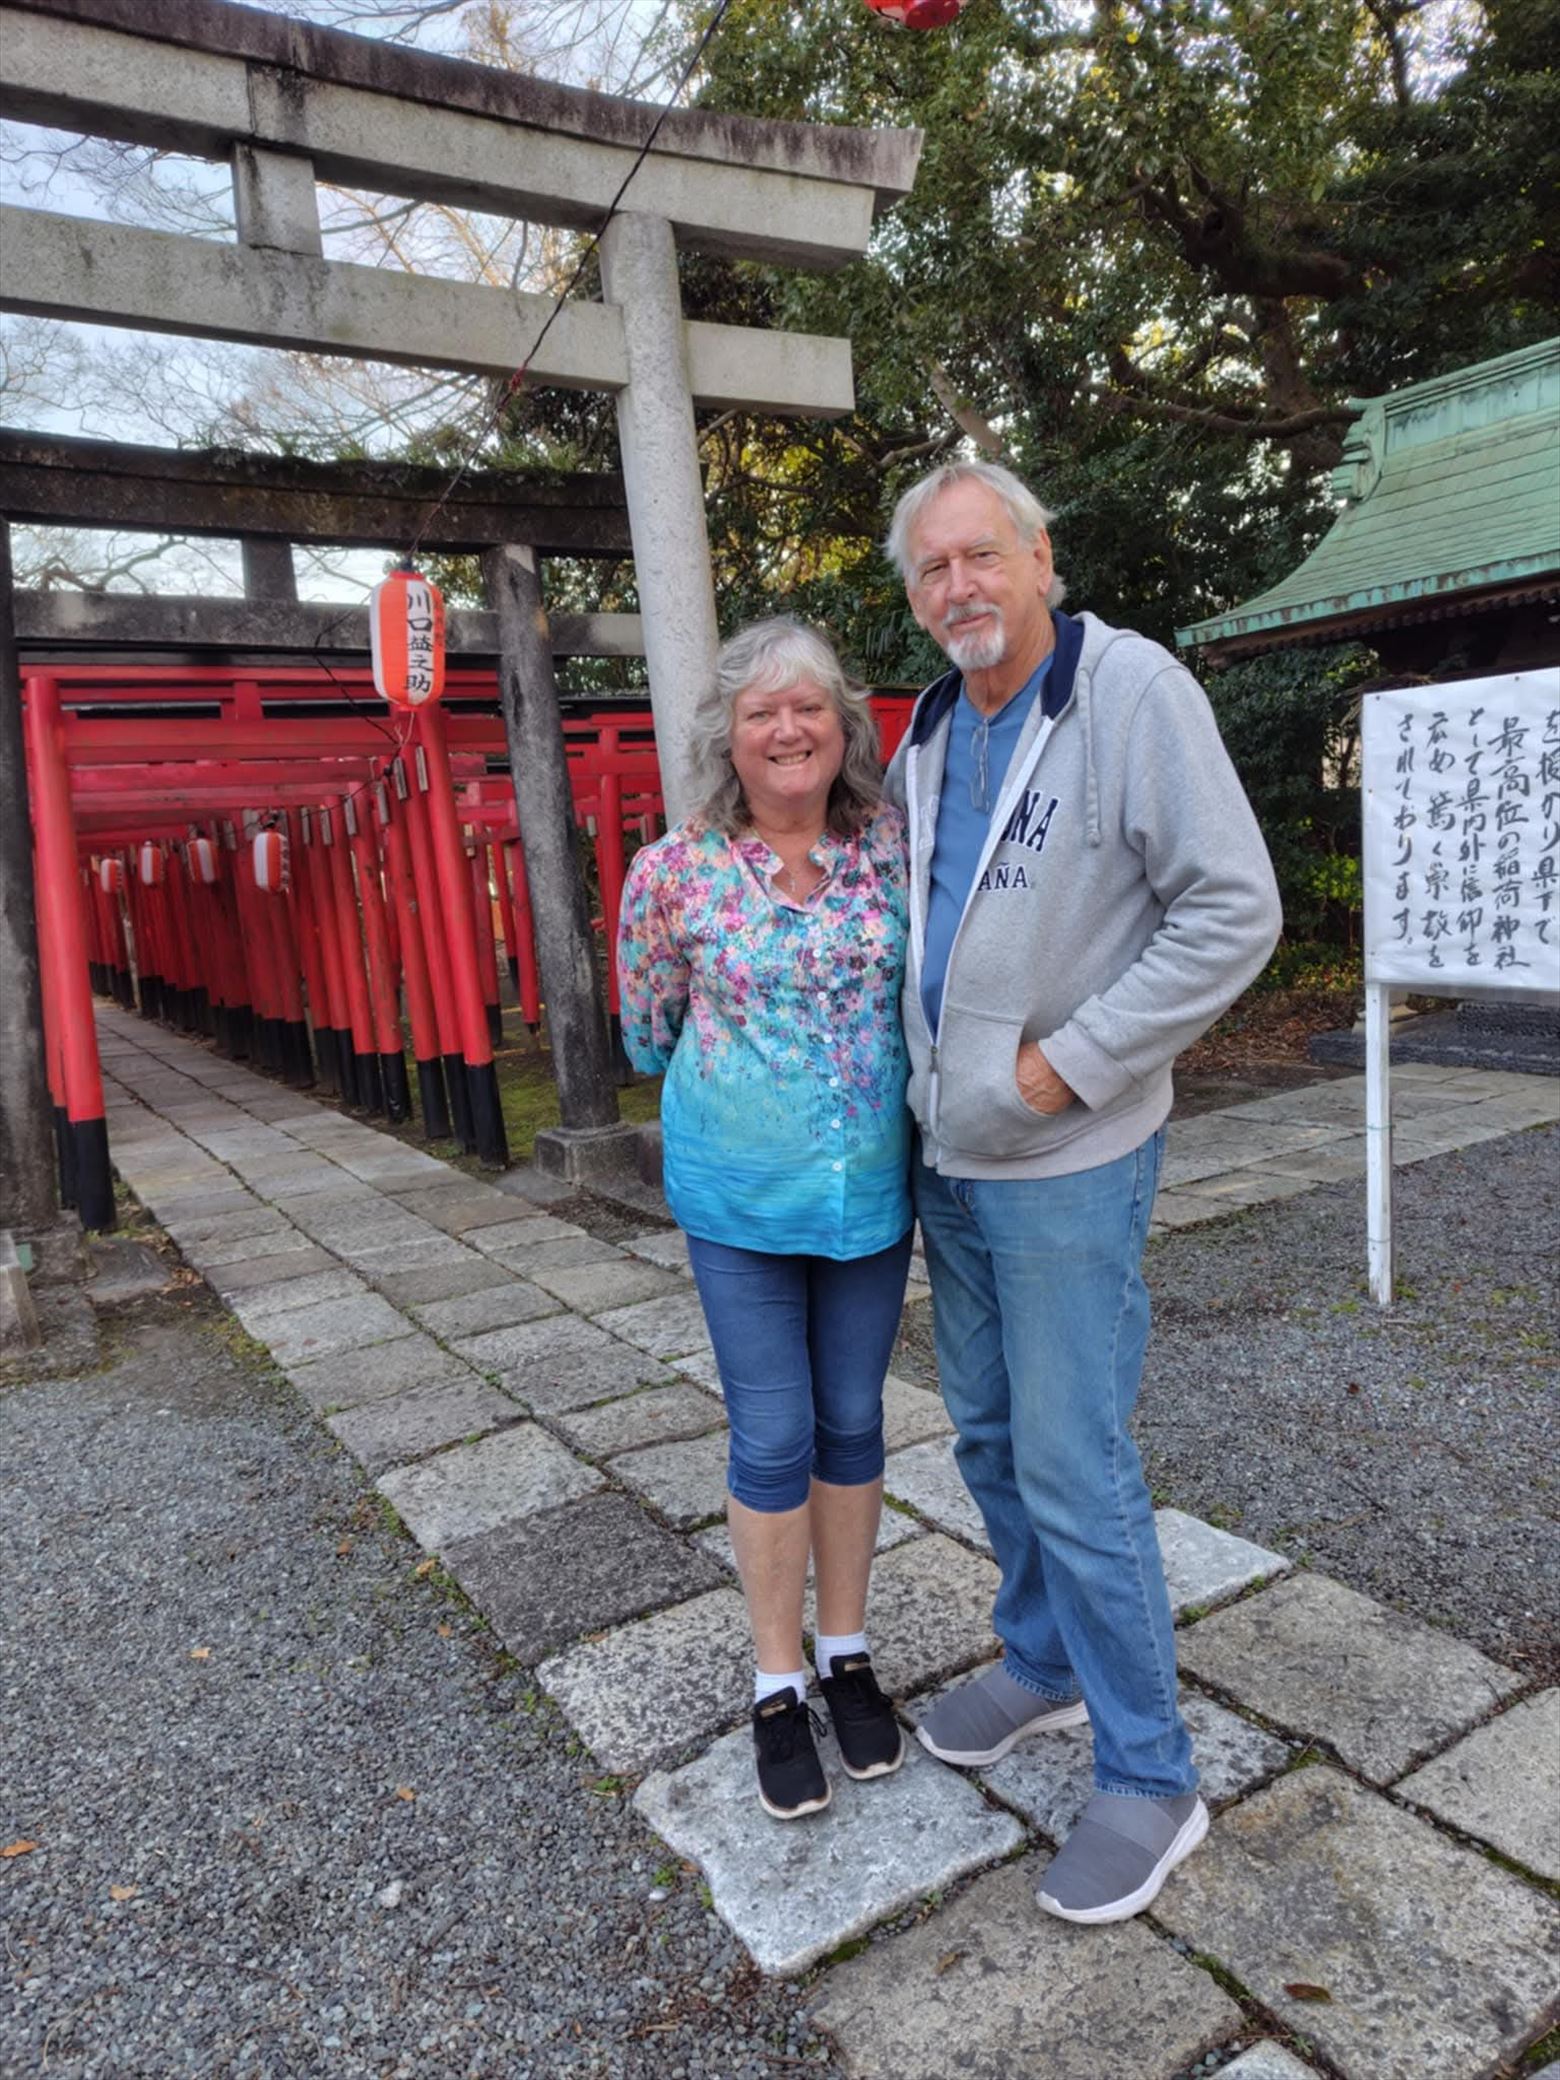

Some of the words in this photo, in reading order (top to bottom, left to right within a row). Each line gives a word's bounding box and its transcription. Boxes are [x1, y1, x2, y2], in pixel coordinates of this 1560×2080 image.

[1454, 706, 1491, 967] として県内外に信仰を
[1488, 716, 1530, 970] 最高位の稲荷神社
